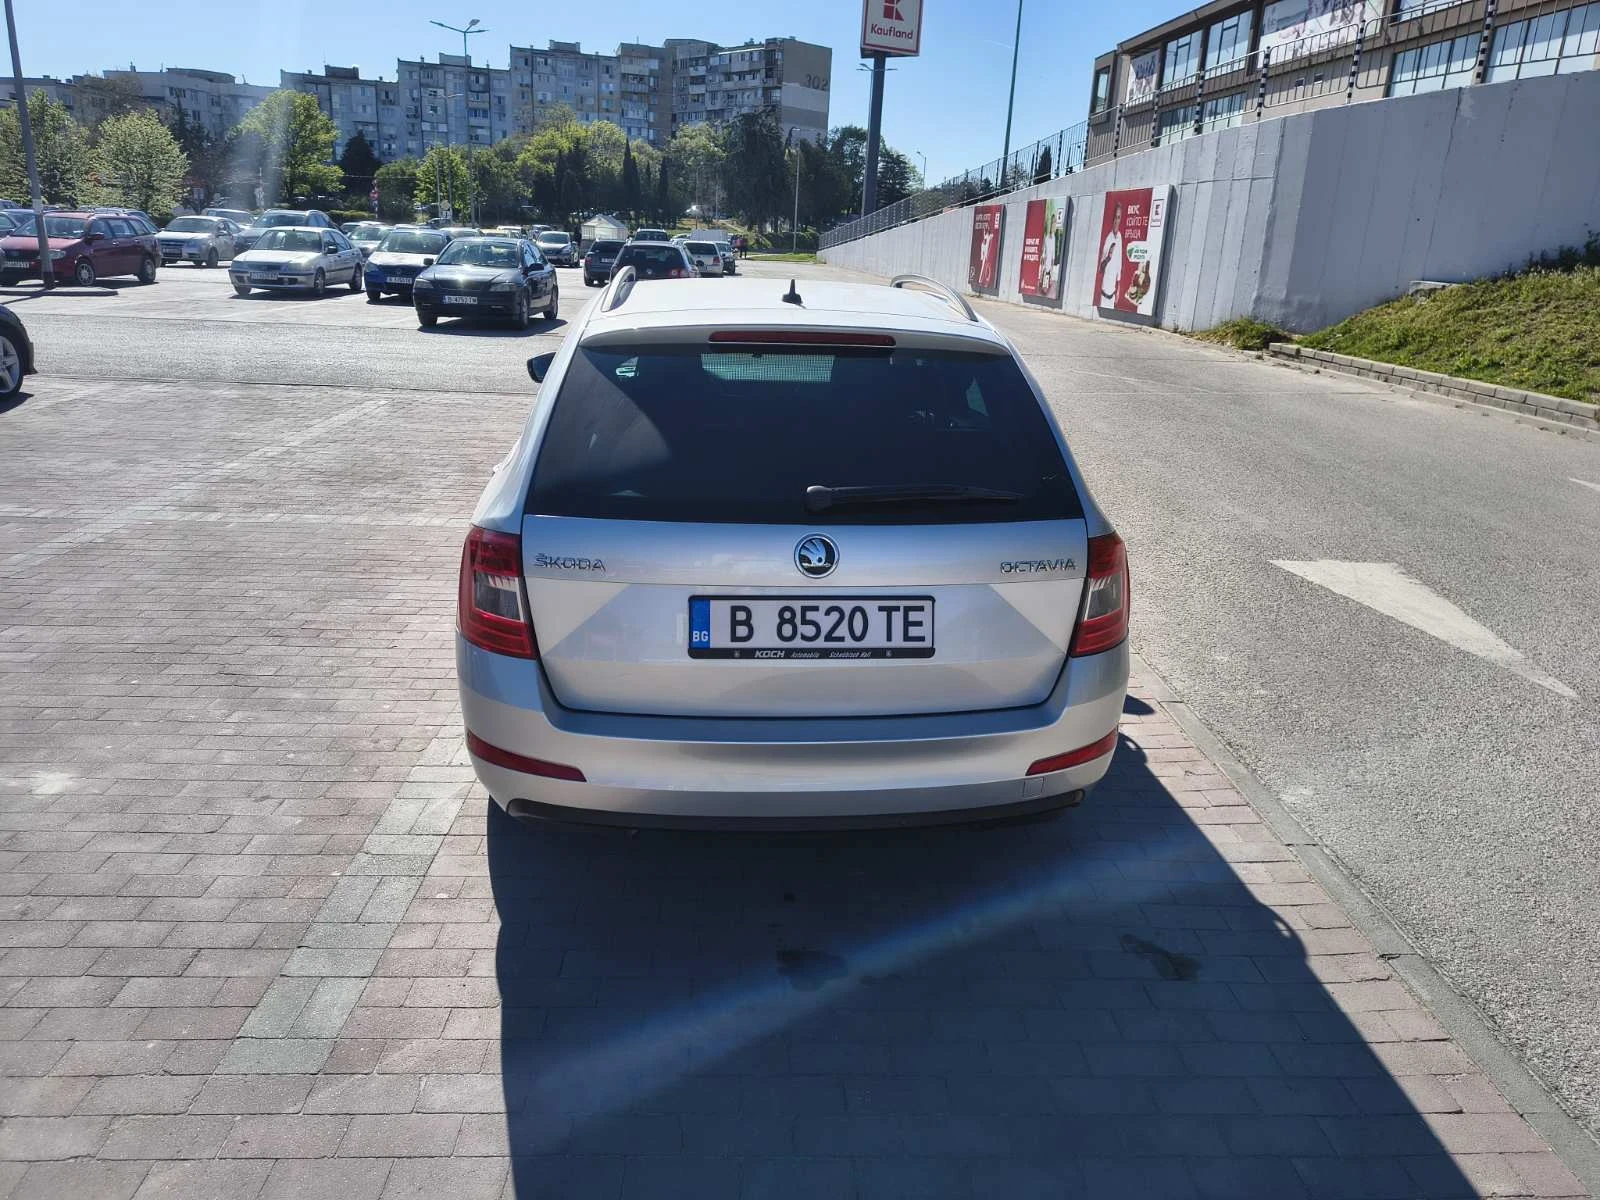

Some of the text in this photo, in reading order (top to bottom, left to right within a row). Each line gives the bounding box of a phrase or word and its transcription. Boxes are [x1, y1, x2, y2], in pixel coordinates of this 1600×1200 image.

[871, 23, 913, 40] Kaufland
[805, 73, 829, 91] 302
[535, 552, 606, 573] ŠKODA
[1000, 558, 1076, 574] OCTAVIA
[729, 605, 926, 643] B 8520 TE
[692, 631, 709, 642] BG
[754, 650, 785, 658] KOCH
